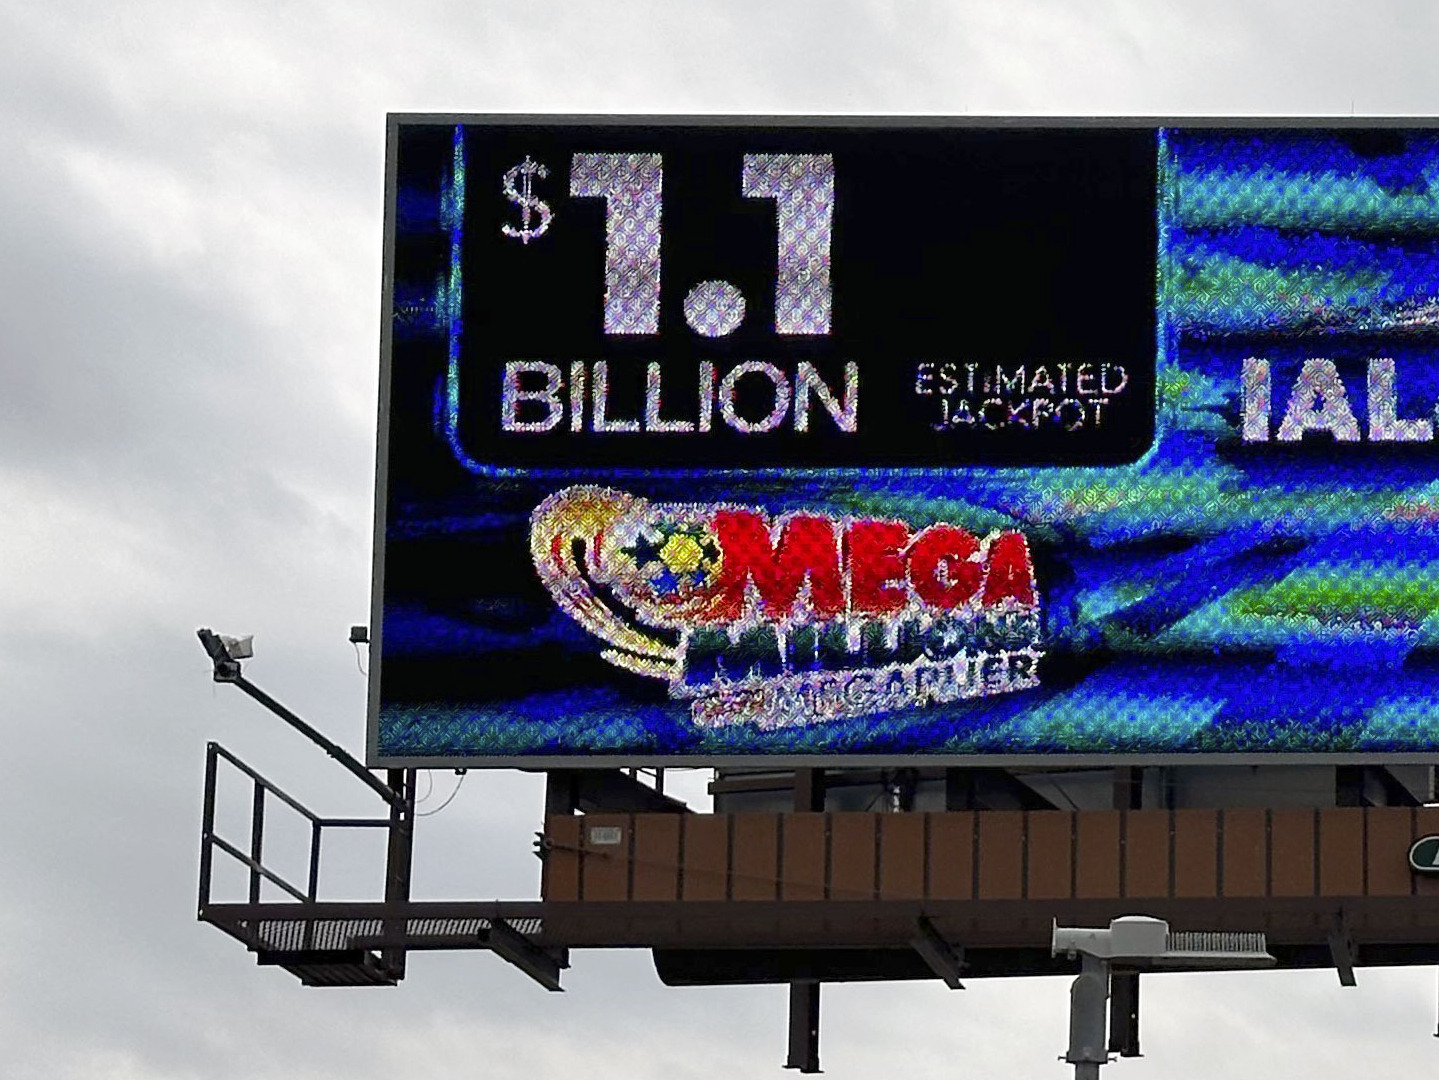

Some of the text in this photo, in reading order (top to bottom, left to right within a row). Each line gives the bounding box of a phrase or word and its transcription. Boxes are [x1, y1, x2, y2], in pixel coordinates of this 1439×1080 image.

[501, 360, 859, 433] BILLION
[914, 361, 1129, 395] ESTIMATED
[933, 398, 1110, 432] JACKPOT
[697, 508, 1037, 620] MEGA
